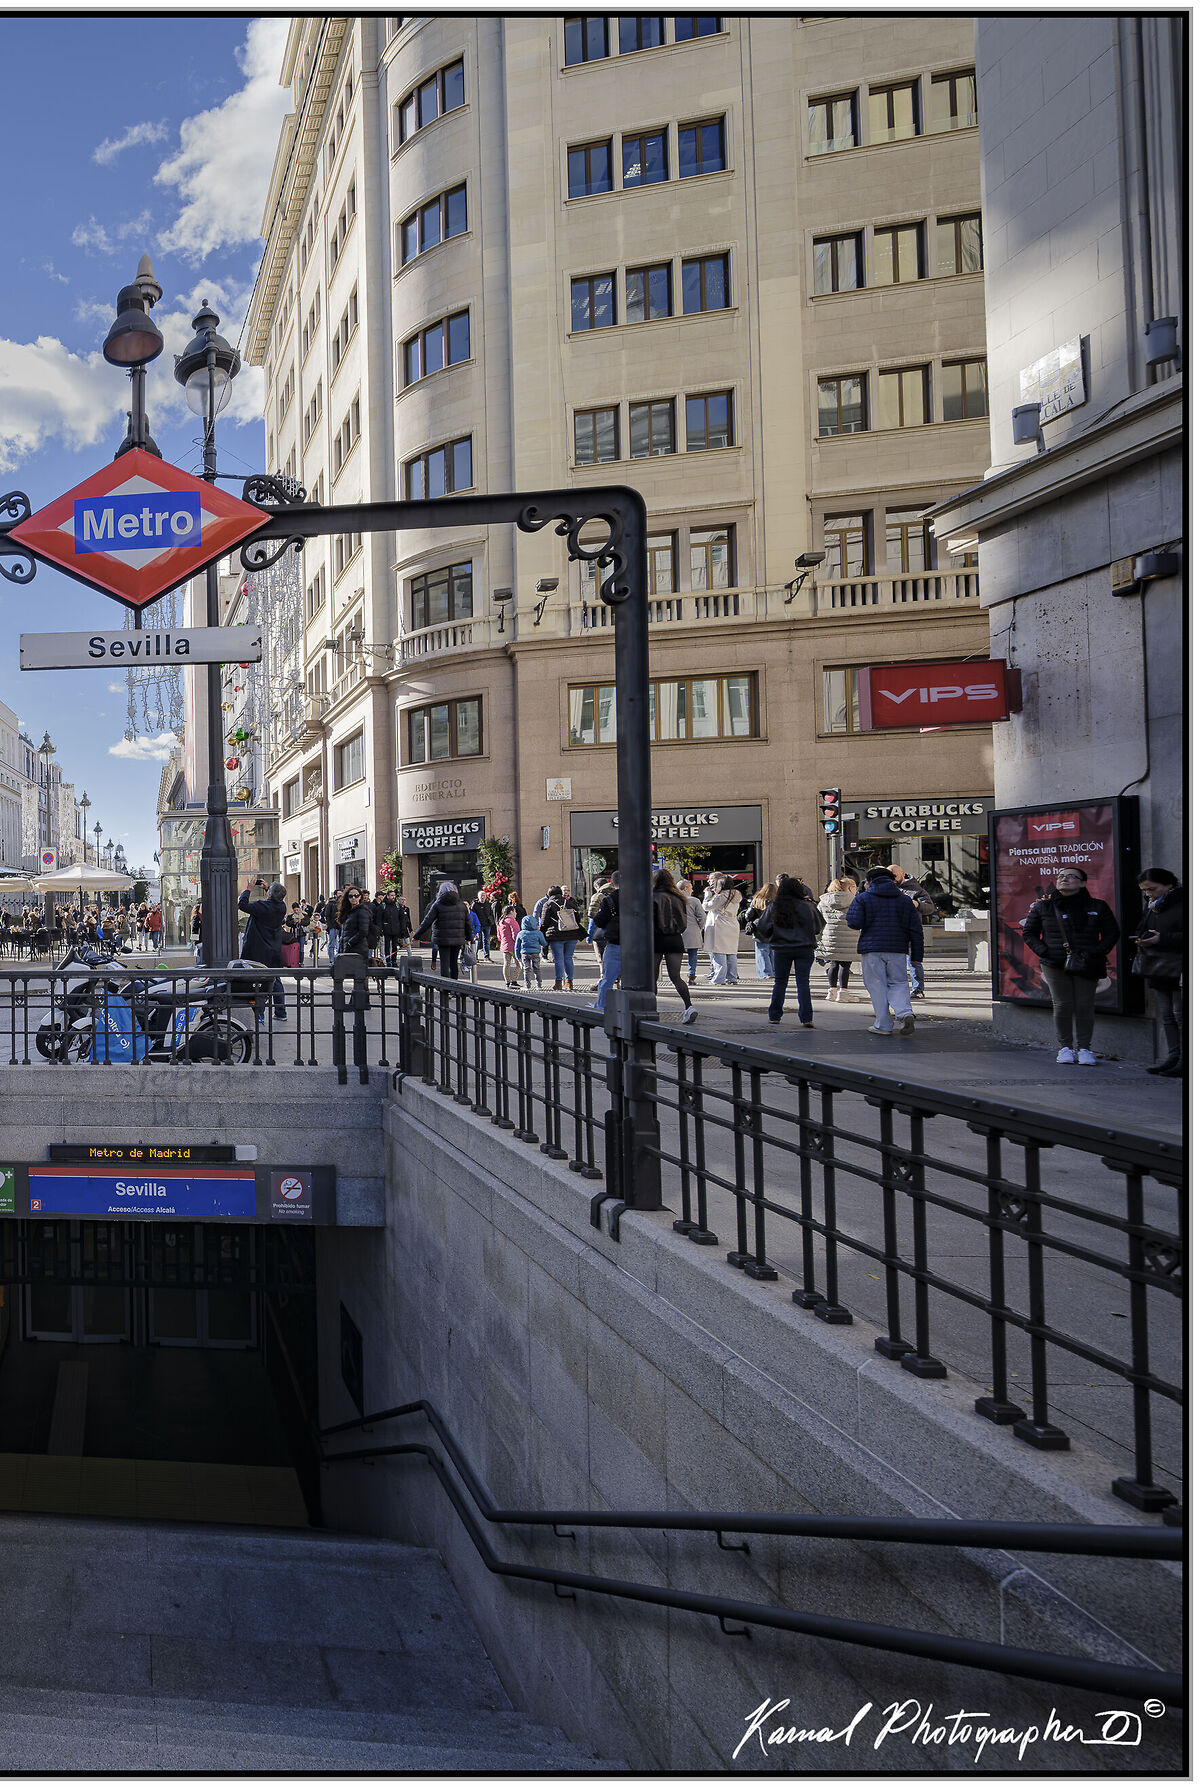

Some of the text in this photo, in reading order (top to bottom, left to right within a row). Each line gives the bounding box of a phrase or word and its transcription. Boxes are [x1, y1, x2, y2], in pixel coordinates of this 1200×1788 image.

[1040, 384, 1076, 407] LLE DE
[1041, 395, 1074, 420] CALA
[83, 507, 194, 541] Metro
[88, 634, 190, 658] Sevilla
[878, 683, 999, 704] VIPS
[415, 779, 462, 792] EDIFICIO
[412, 789, 466, 801] GENERALI
[867, 803, 984, 819] STARBUCKS
[612, 813, 719, 828] SRBUCKS
[888, 819, 962, 832] COFFEE
[1032, 821, 1075, 831] VIPS
[402, 822, 480, 838] STARBUCKS
[651, 826, 700, 839] OFFEE
[416, 835, 465, 848] COFFEE
[1009, 841, 1104, 856] Piensa una TRADICIÓN
[1020, 854, 1092, 866] NAVIDEÑA mejor.
[1040, 866, 1065, 876] No ha
[89, 1148, 191, 1158] Metro de Madrid
[115, 1182, 167, 1197] Sevilla
[155, 1206, 176, 1214] Alcalá
